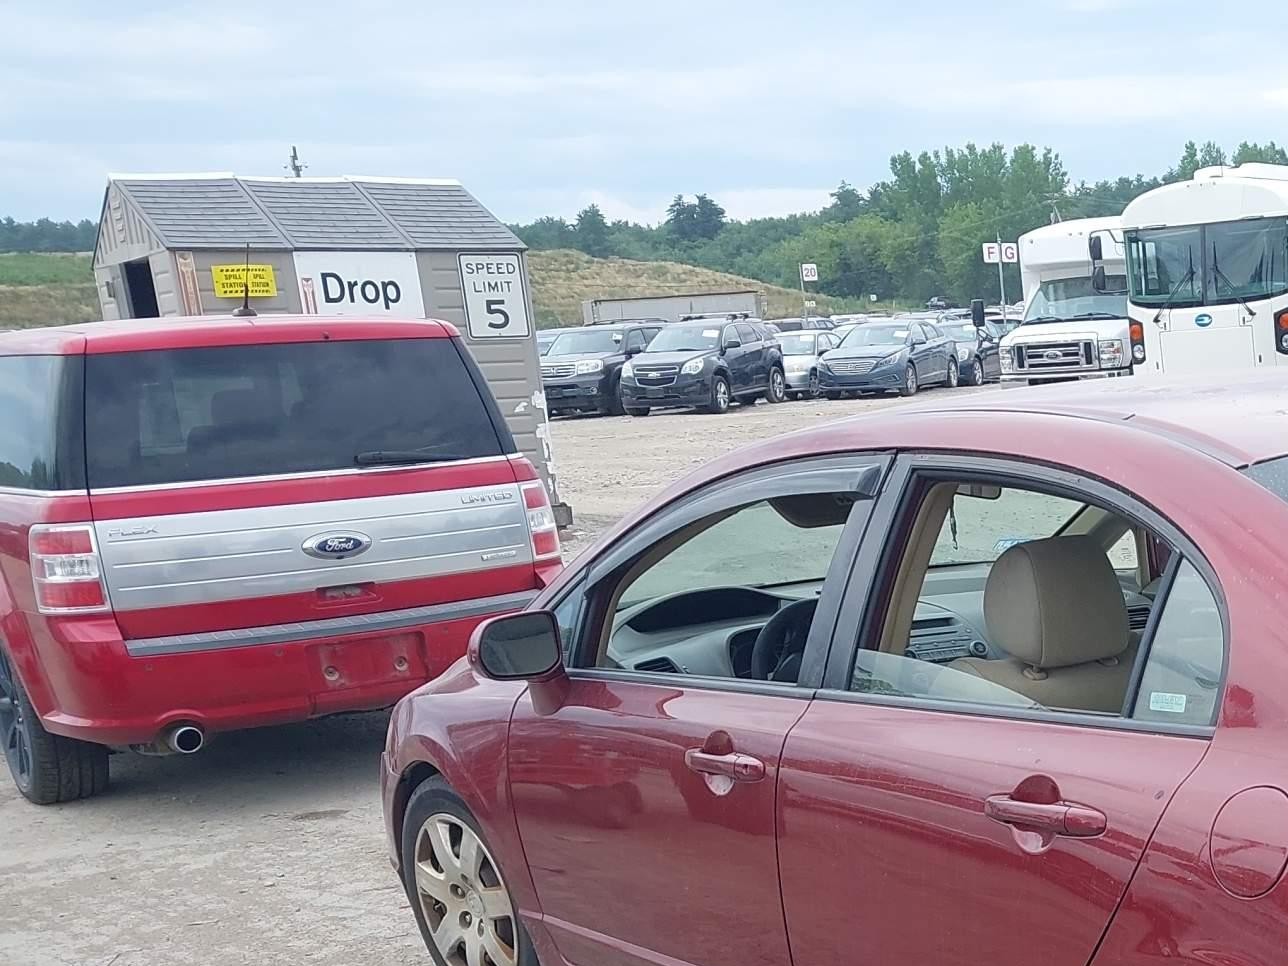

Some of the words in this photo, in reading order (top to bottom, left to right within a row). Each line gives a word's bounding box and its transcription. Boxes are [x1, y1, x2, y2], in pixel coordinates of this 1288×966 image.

[987, 246, 996, 260] F
[1004, 246, 1015, 260] G
[465, 262, 516, 275] SPEED
[804, 267, 817, 278] 20
[319, 272, 401, 310] Drop
[473, 280, 513, 293] LIMIT
[485, 299, 510, 329] 5
[461, 490, 513, 504] LIMITED
[108, 526, 159, 536] FLEX
[325, 538, 355, 551] Ford
